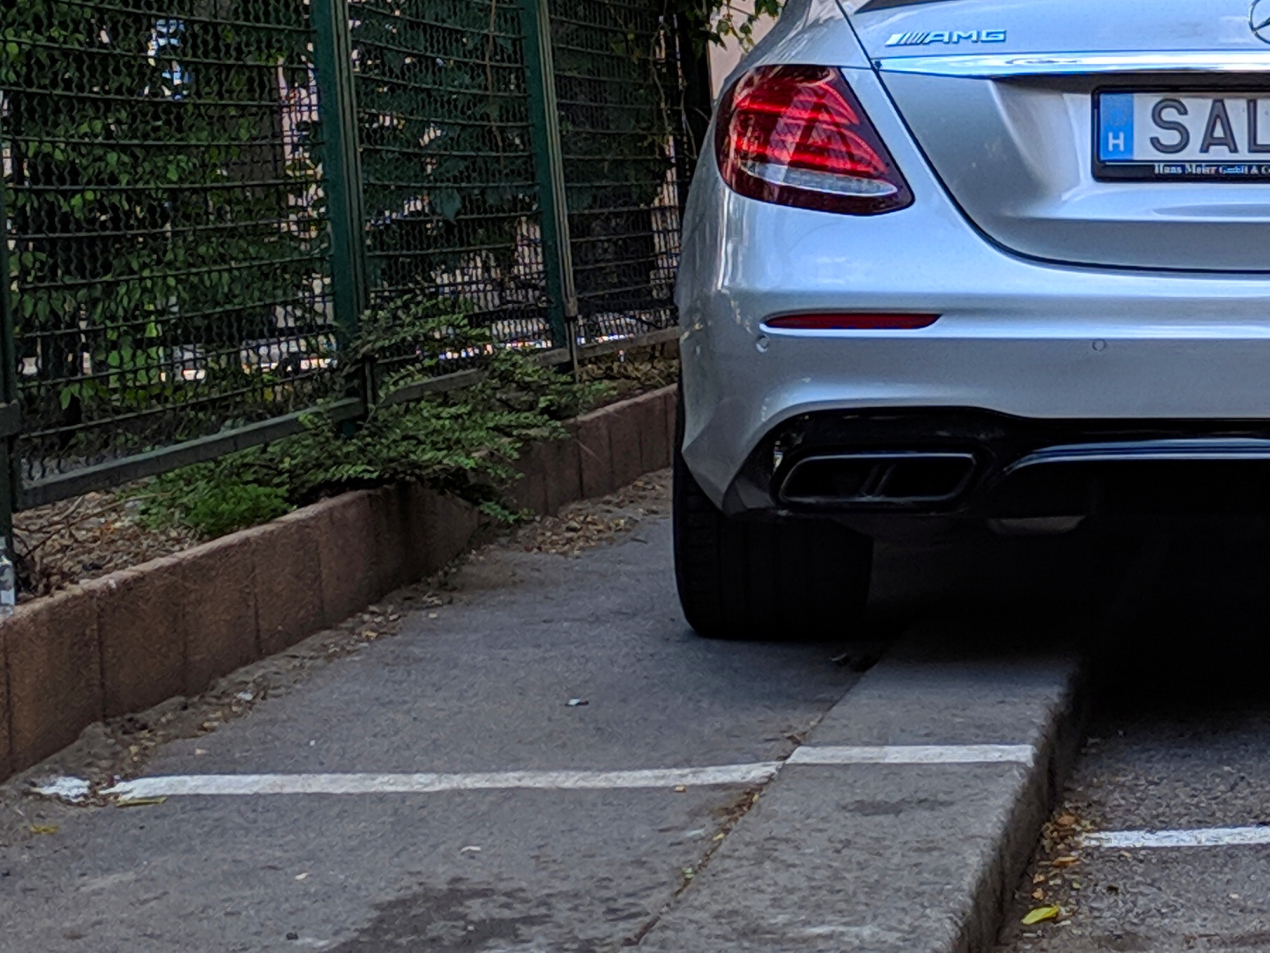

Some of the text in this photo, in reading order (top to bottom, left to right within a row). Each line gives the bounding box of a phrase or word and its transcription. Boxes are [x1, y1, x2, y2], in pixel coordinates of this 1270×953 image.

[921, 29, 1007, 45] AMG
[1108, 132, 1125, 152] H
[1154, 163, 1182, 175] Hans
